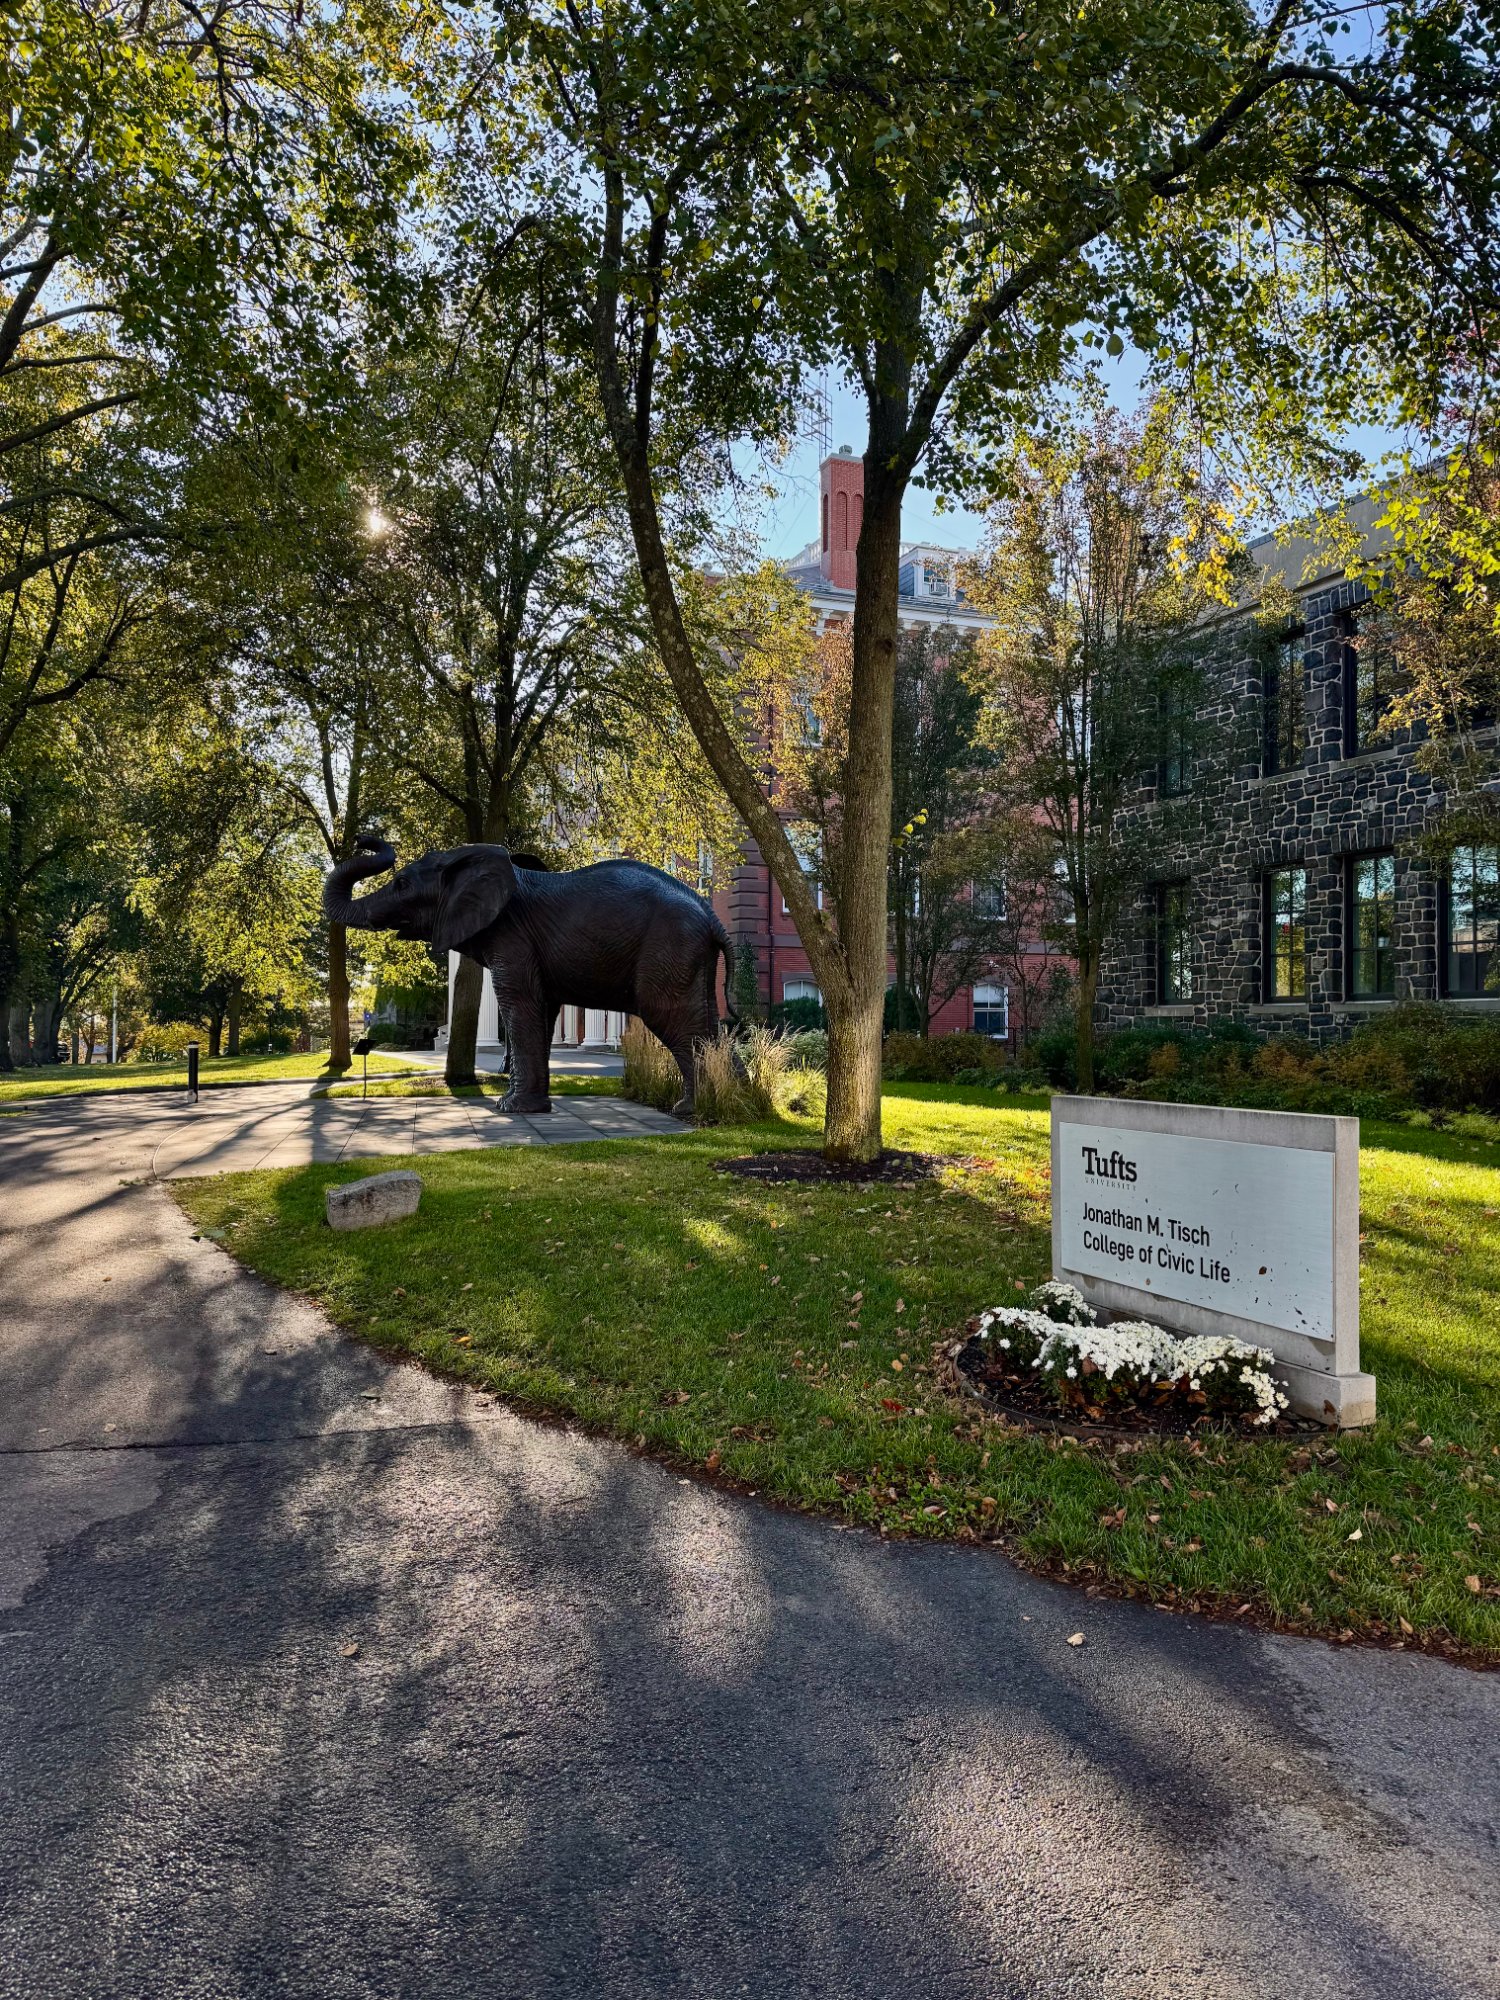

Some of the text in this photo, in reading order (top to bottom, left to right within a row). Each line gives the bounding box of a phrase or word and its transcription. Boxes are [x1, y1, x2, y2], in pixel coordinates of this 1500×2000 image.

[1082, 1146, 1137, 1182] Tufts
[1083, 1202, 1210, 1247] Jonathan M. Tisch
[1083, 1230, 1230, 1283] College of Civic Life
